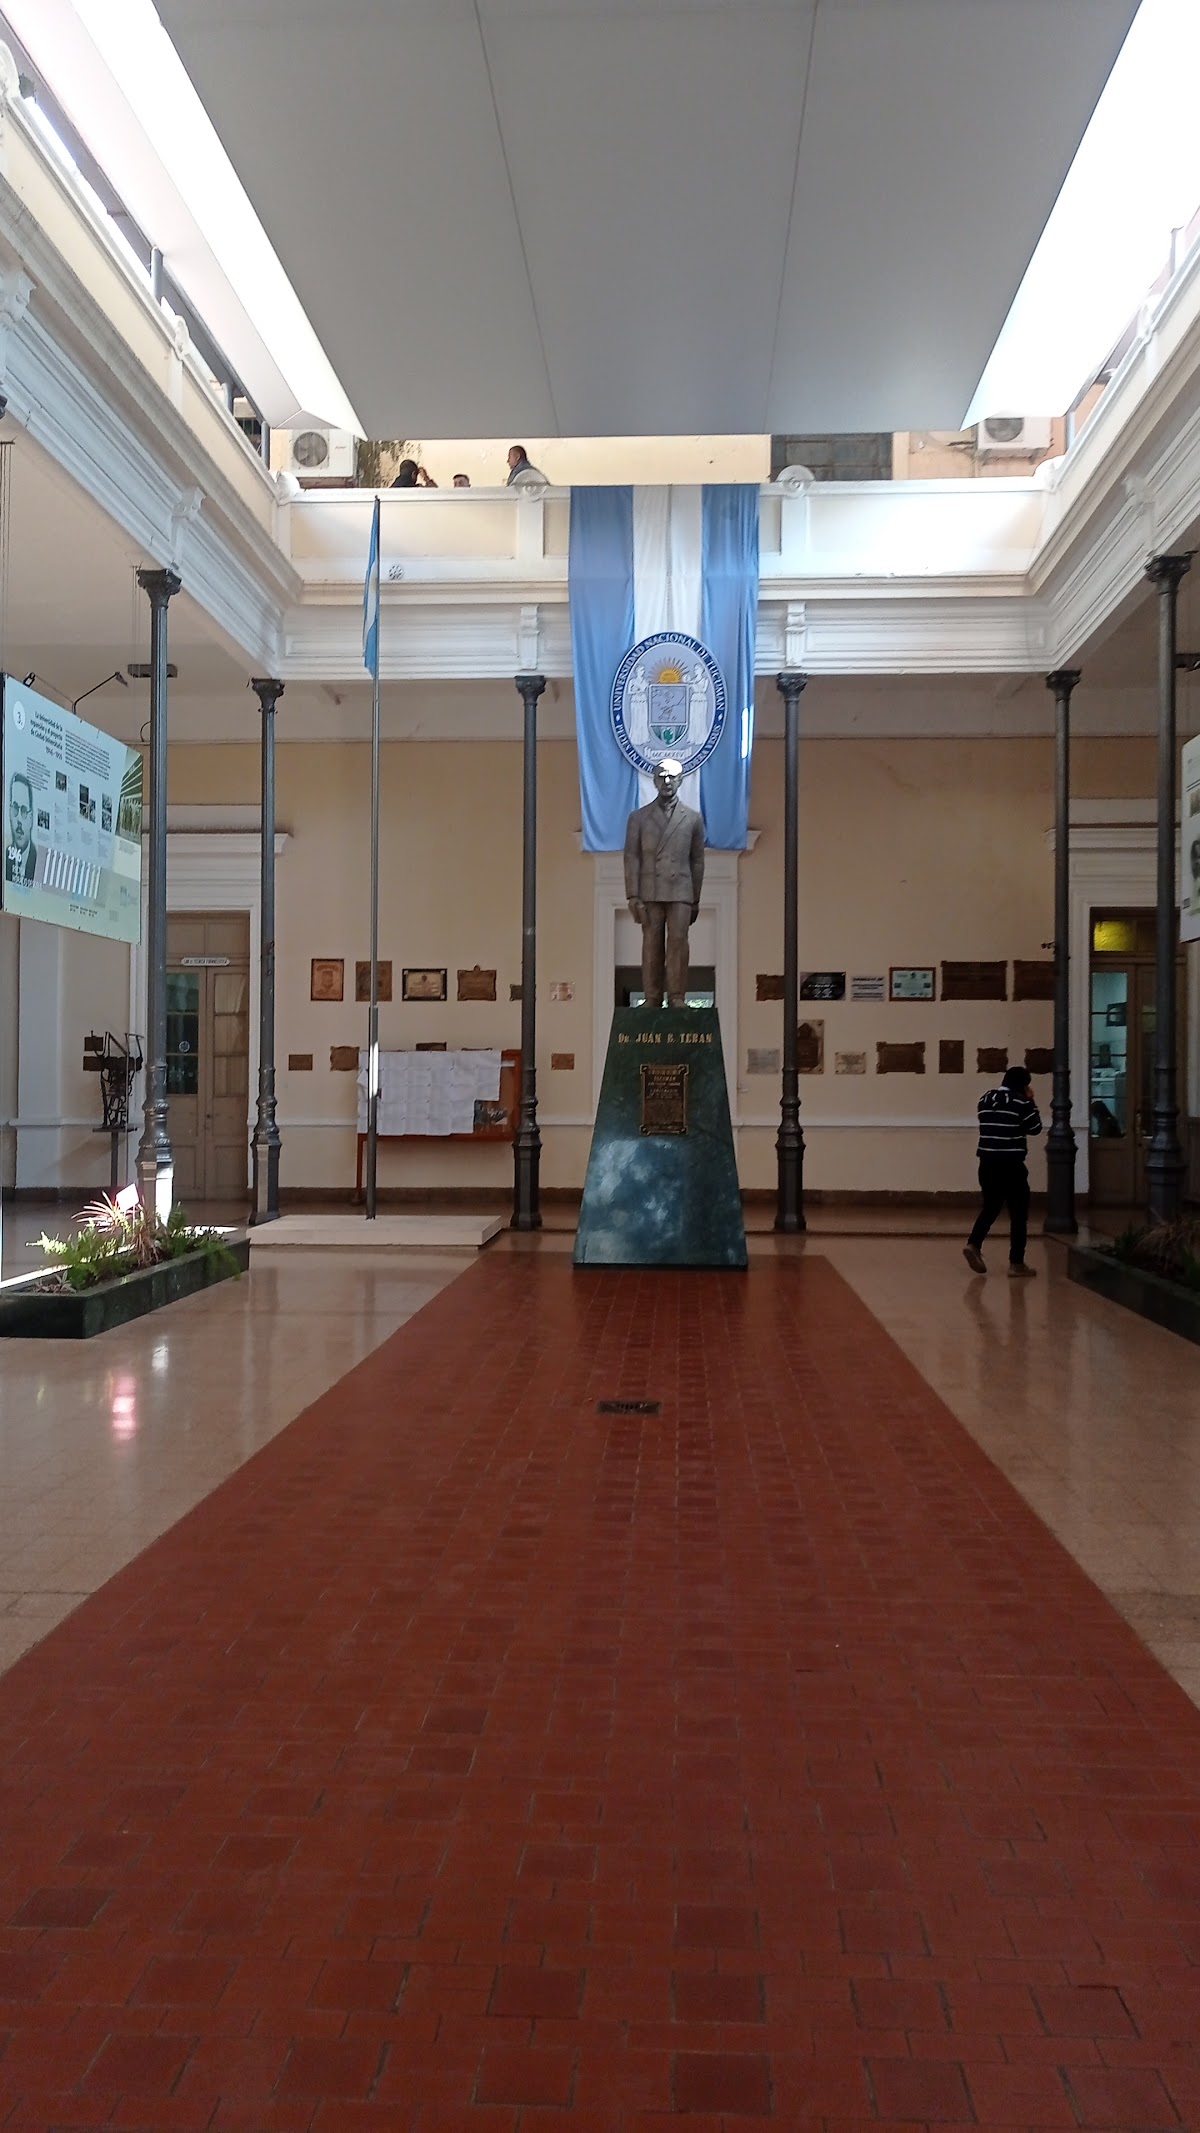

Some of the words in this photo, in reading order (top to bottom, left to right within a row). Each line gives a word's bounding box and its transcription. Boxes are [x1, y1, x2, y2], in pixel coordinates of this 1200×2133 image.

[613, 645, 646, 711] UNIVERSIDAD
[644, 633, 698, 650] NACIONAL
[635, 1032, 662, 1044] JUAN
[680, 1032, 713, 1044] TERAN
